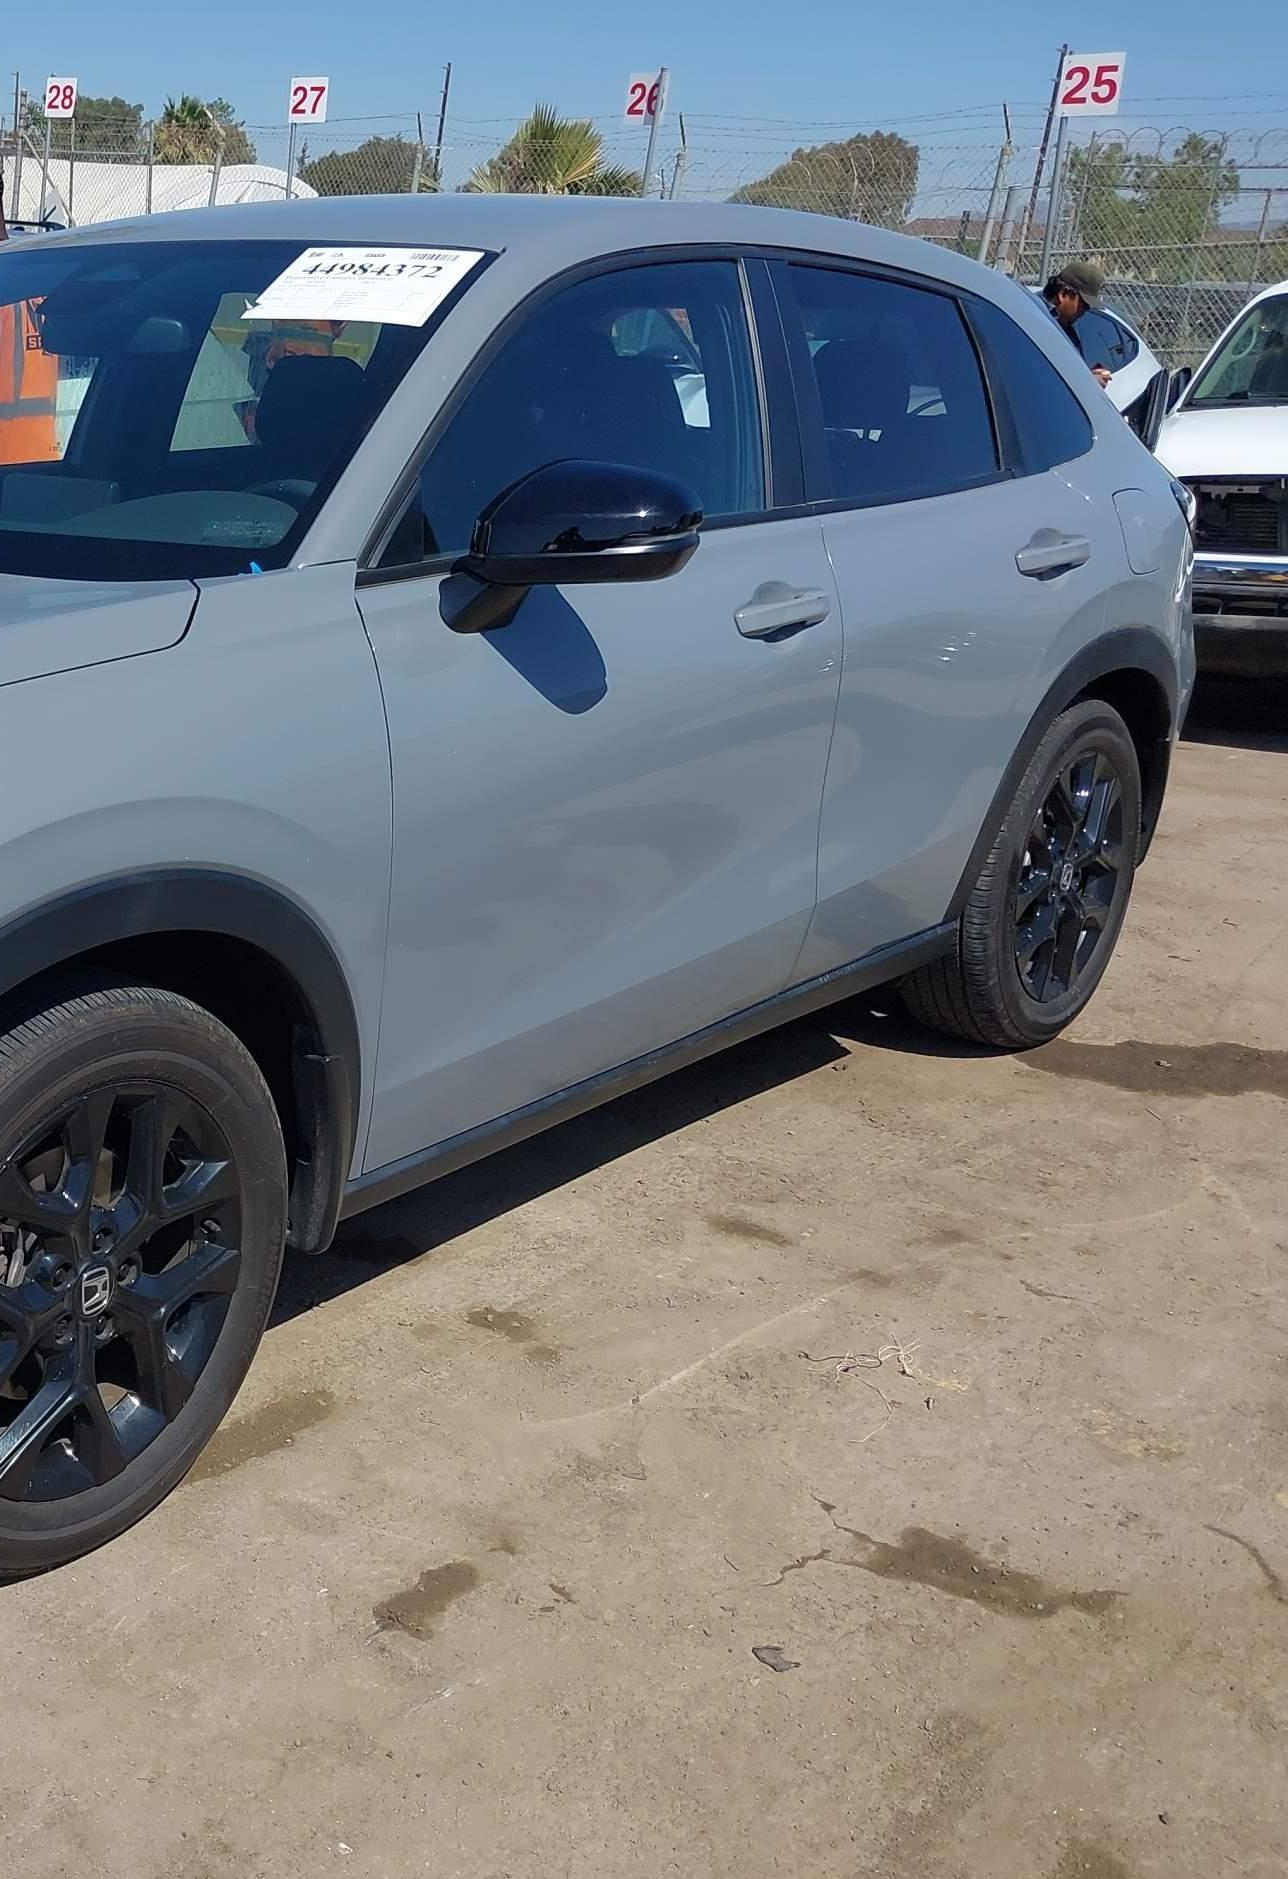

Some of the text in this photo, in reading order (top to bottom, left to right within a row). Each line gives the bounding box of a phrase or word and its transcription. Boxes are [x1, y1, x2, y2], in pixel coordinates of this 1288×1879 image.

[47, 84, 75, 110] 28
[626, 82, 664, 116] 26
[1061, 65, 1119, 104] 25
[290, 86, 326, 115] 27
[301, 261, 444, 279] 44984372
